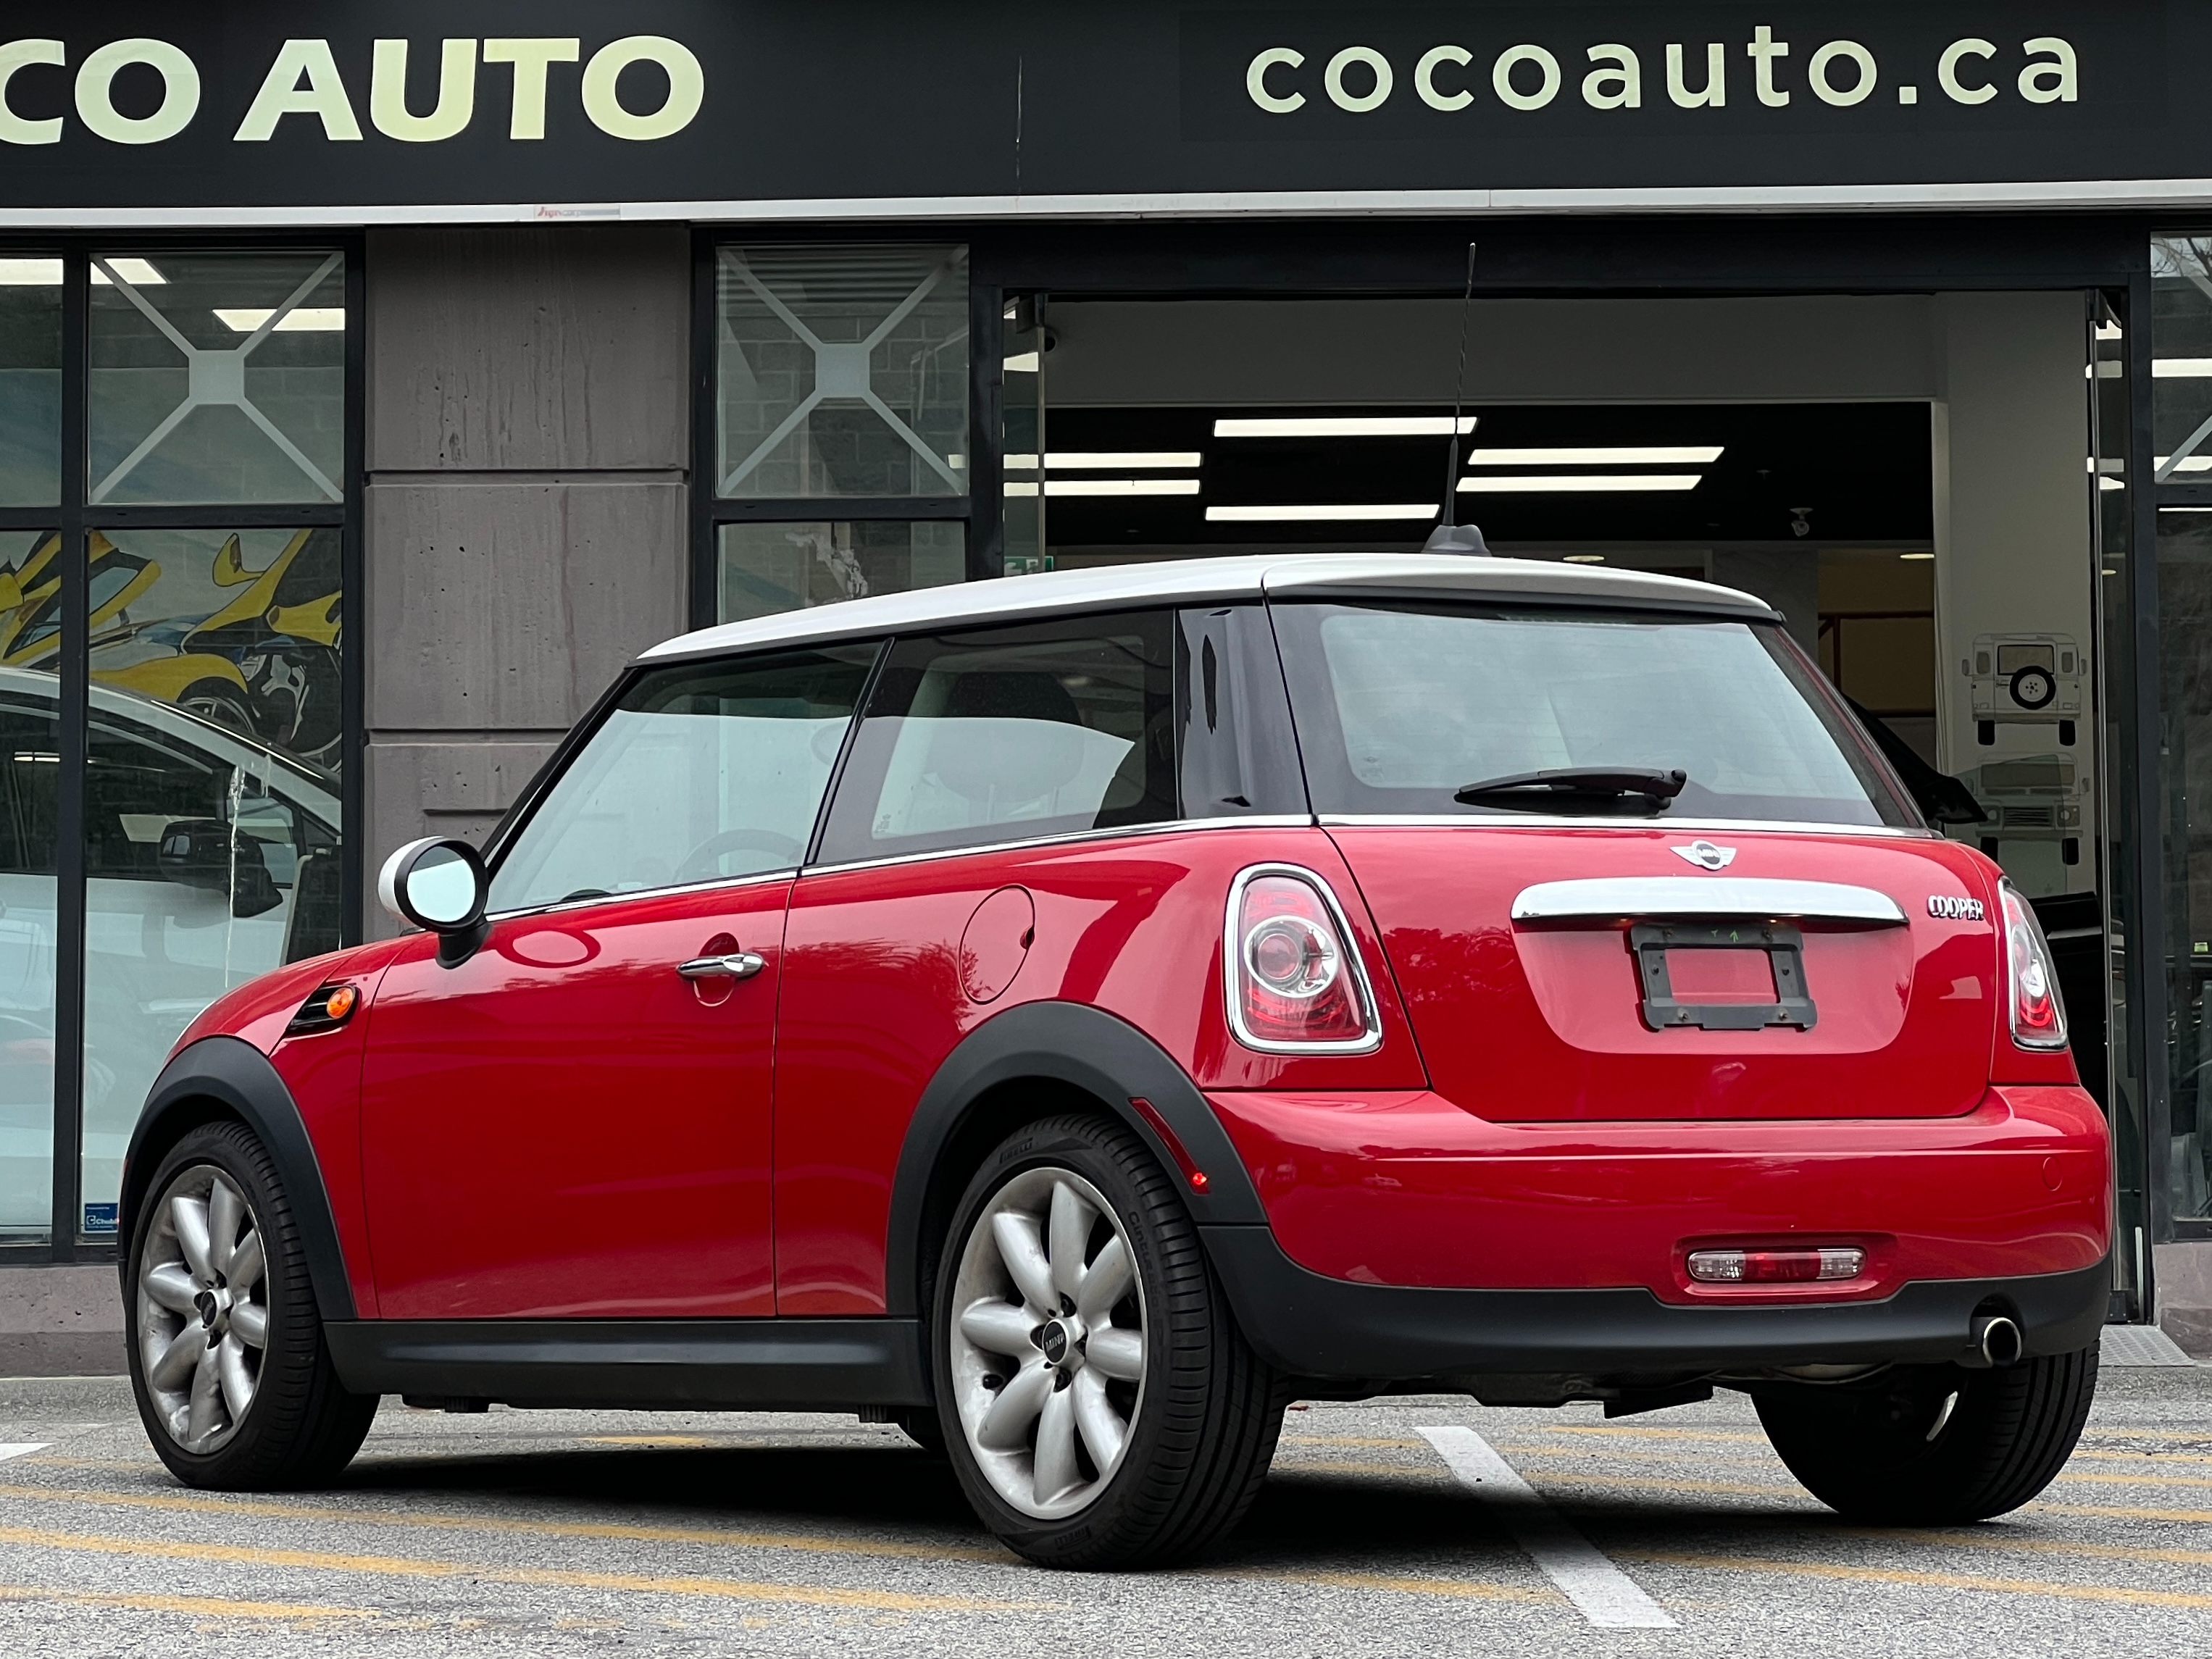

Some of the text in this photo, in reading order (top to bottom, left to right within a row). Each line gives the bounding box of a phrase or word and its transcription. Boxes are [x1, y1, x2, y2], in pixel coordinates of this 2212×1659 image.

[0, 35, 704, 145] CO AUTO
[1246, 25, 2078, 114] cocoauto.ca
[1927, 895, 1984, 920] COOPER
[1045, 1332, 1065, 1353] MINI
